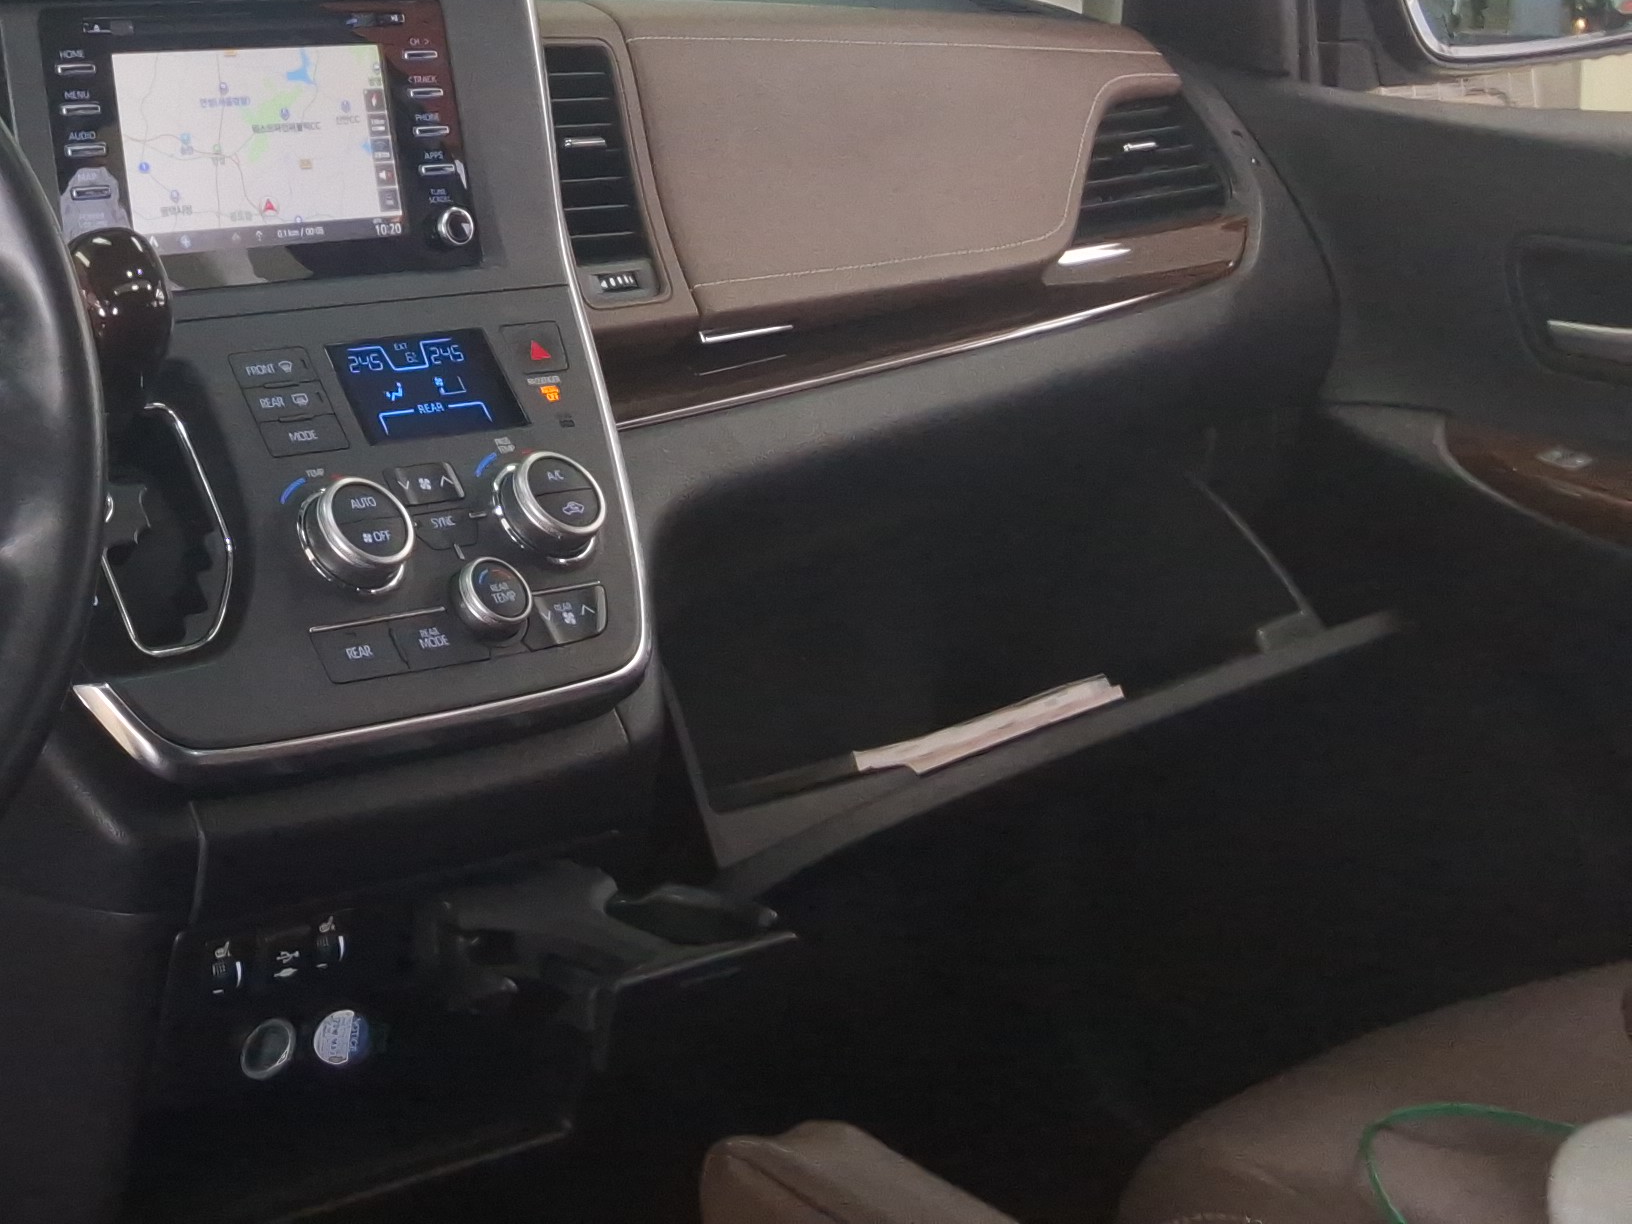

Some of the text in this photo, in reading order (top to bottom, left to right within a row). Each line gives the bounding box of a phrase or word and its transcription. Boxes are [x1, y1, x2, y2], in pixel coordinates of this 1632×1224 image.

[375, 223, 402, 236] 10:20
[246, 363, 276, 376] FRONT
[259, 396, 286, 409] REAR
[417, 402, 445, 414] REAR
[288, 429, 319, 442] MODE
[350, 496, 377, 510] AUTO
[430, 515, 457, 529] SYNC
[373, 530, 392, 542] OFF
[491, 590, 517, 604] TEMP
[419, 634, 451, 650] MODE
[345, 644, 374, 660] REAR
